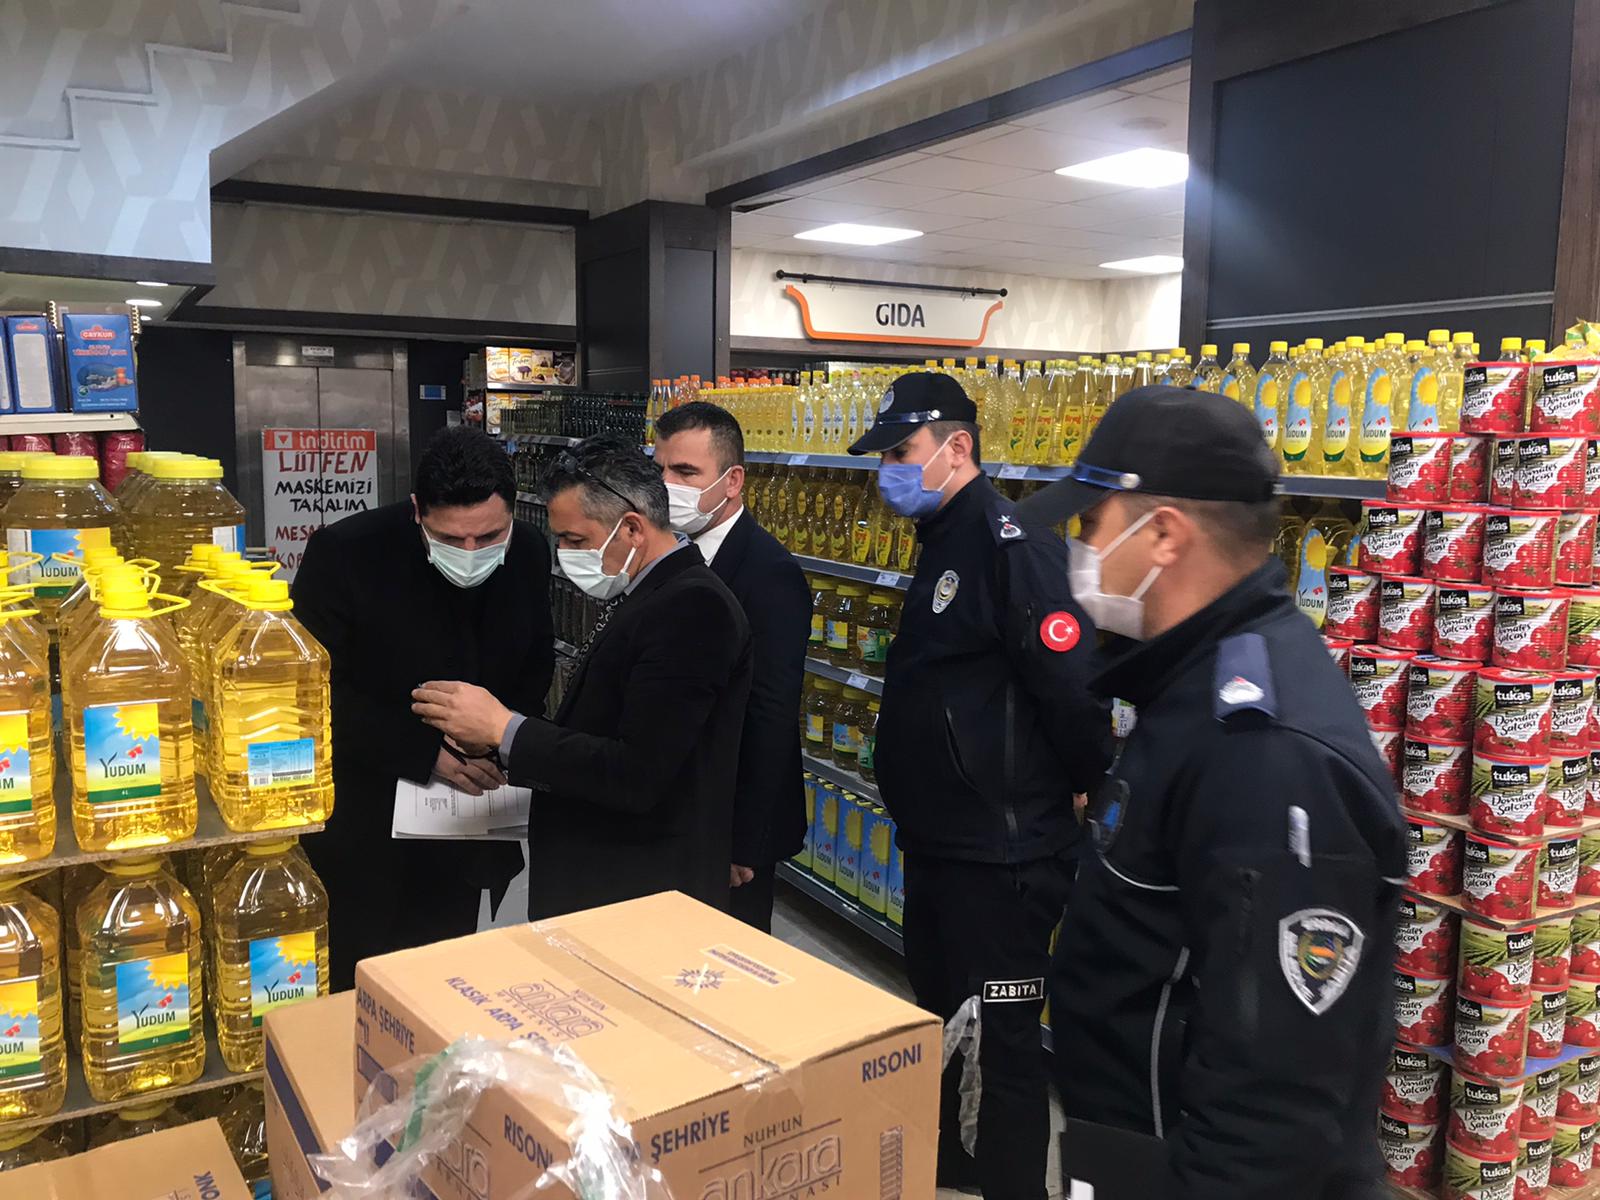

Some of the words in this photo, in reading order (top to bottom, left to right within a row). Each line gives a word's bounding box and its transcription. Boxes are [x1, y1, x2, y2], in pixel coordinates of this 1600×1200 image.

[875, 303, 925, 328] GIDA
[299, 431, 367, 450] indirim
[1362, 421, 1387, 438] YUDUM
[278, 450, 369, 474] LÜTFEN
[289, 498, 368, 513] TAKALIM
[38, 556, 78, 577] YUDUM
[99, 752, 146, 778] YUDUM
[264, 979, 305, 1003] YUDUM
[990, 984, 1037, 997] ZABITA
[131, 1003, 176, 1029] YUDUM
[861, 1042, 922, 1083] RISONI
[650, 1110, 730, 1164] ŞEHRİYE
[743, 1114, 803, 1148] NUH'UN
